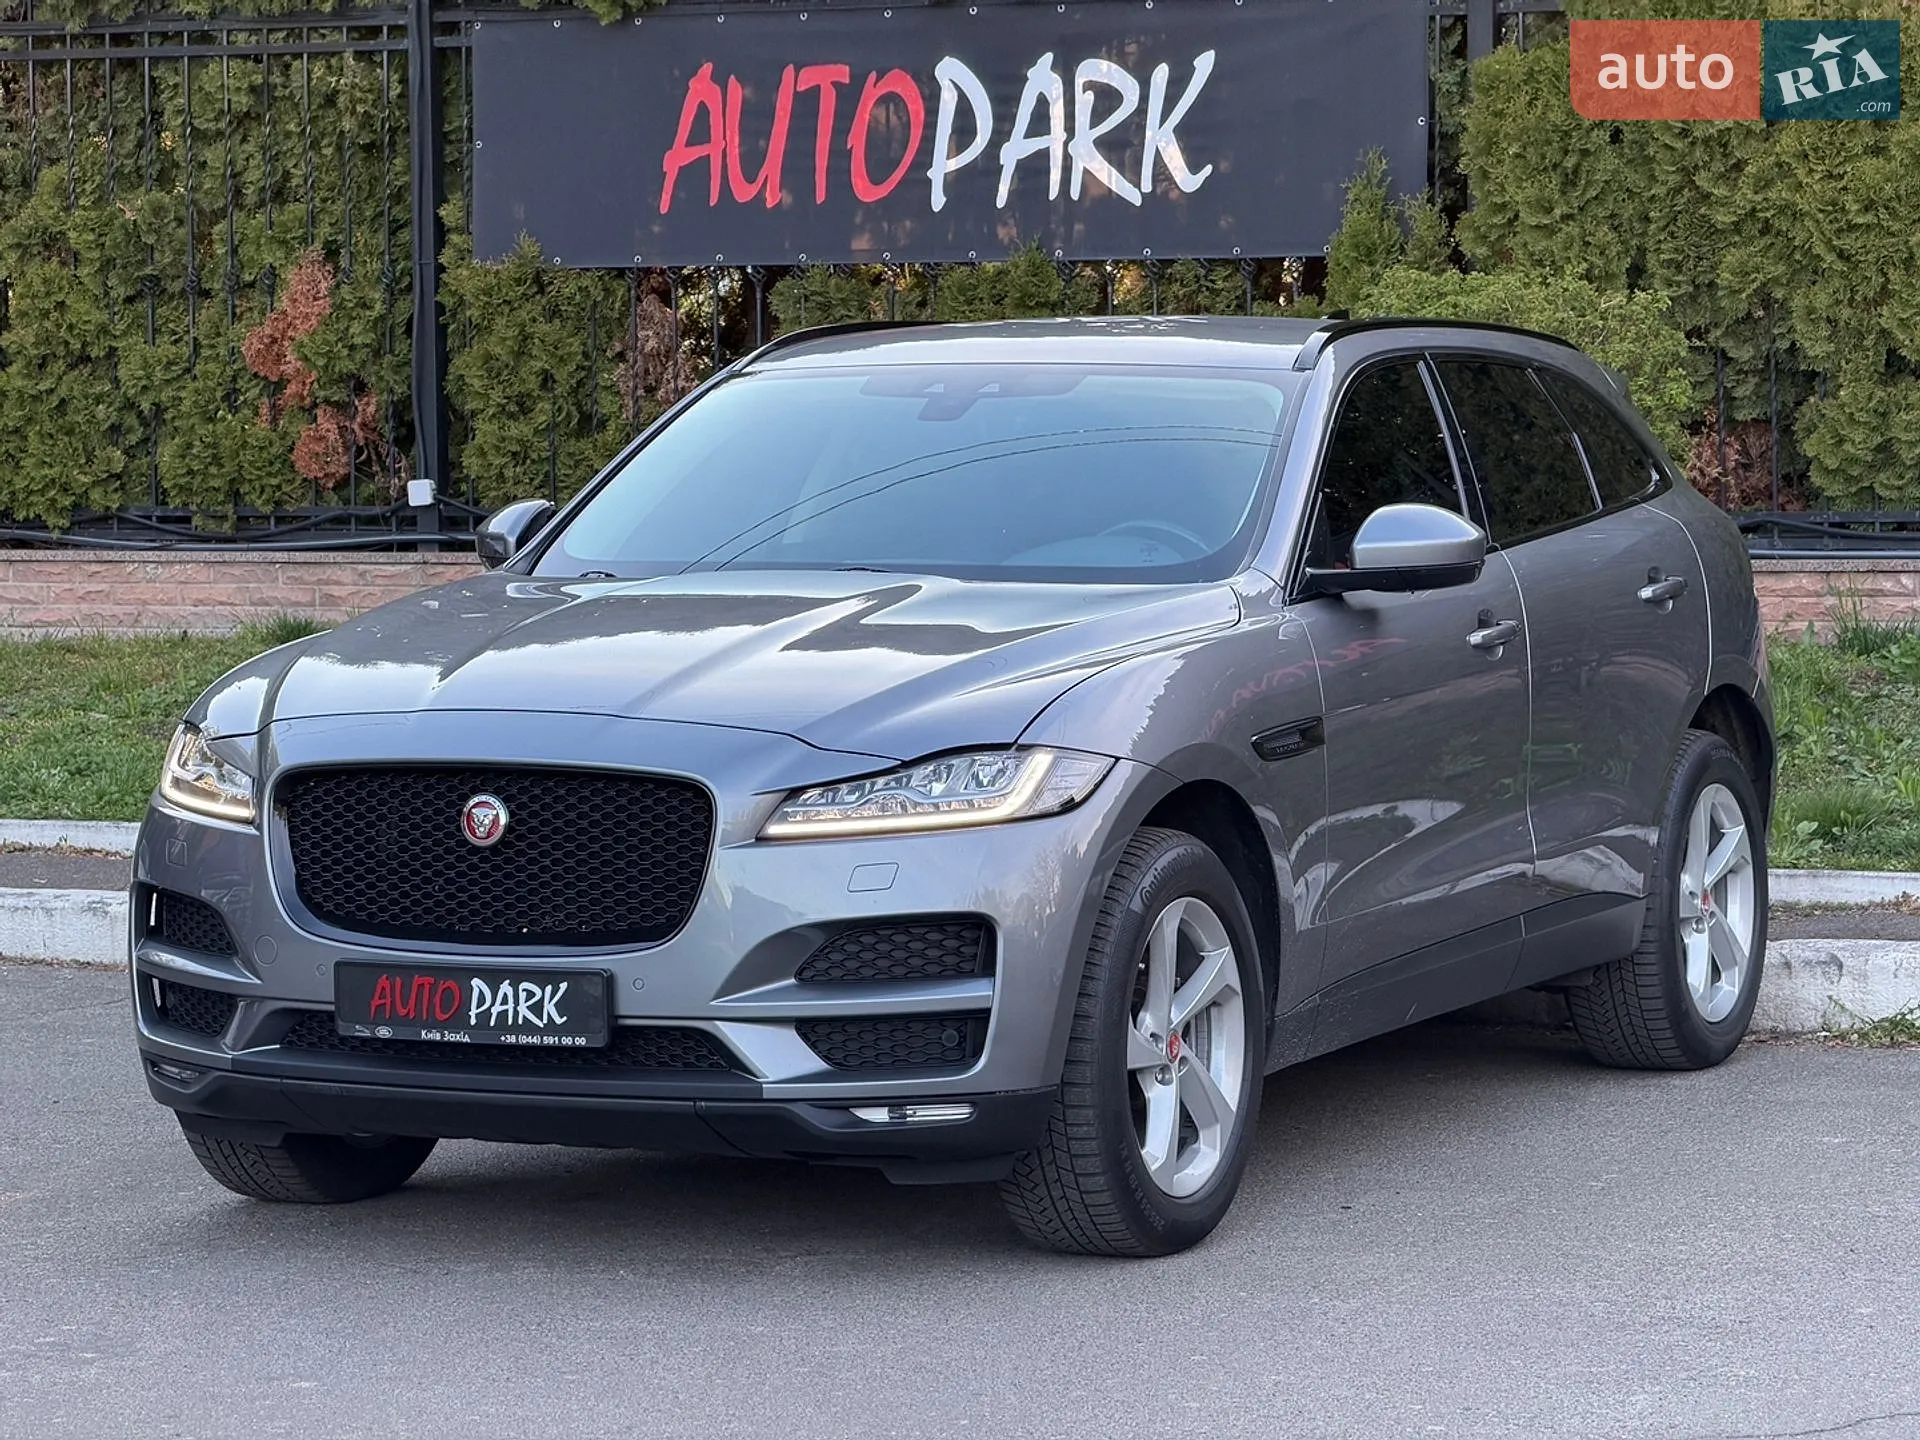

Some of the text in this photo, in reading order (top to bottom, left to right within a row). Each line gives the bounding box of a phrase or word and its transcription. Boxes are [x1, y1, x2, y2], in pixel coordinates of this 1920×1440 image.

[421, 1029, 441, 1041] Київ
[500, 1034, 587, 1046] +38 (044) 591 00 00
